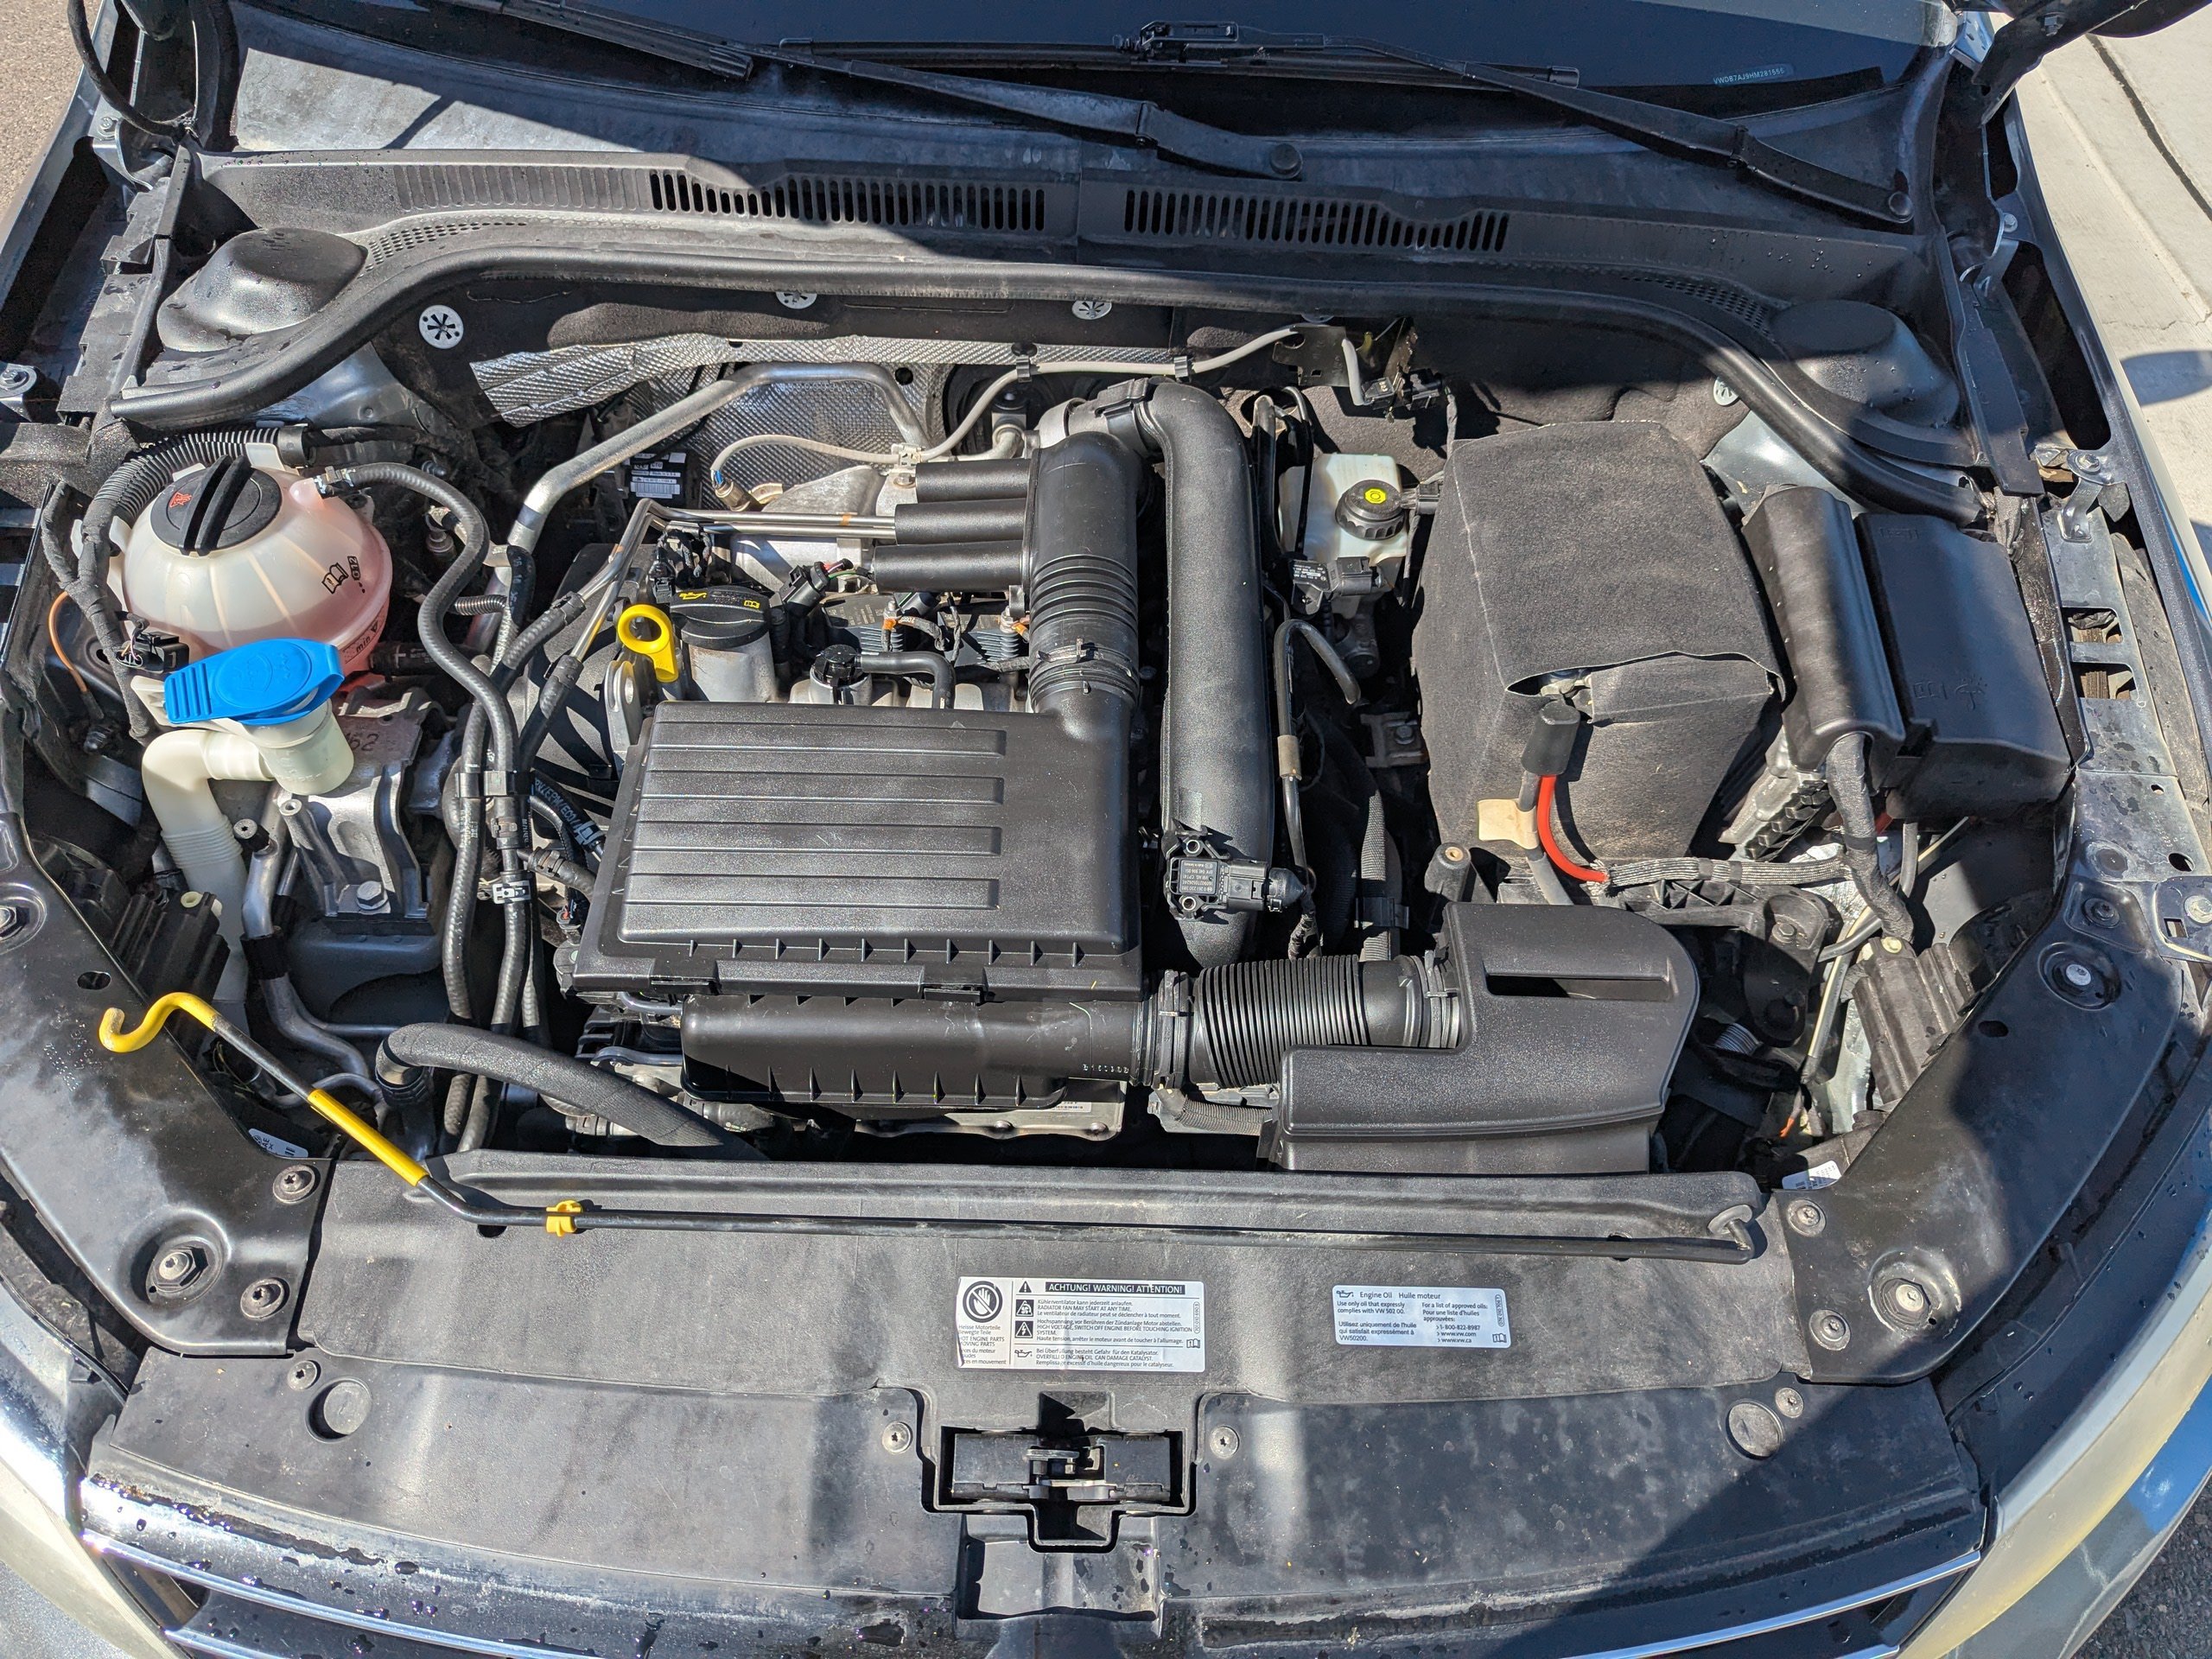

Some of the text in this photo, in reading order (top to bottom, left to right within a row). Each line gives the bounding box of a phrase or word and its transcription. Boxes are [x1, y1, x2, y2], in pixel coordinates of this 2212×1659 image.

[356, 636, 371, 653] min
[1093, 1285, 1134, 1293] WARNING!
[1136, 1285, 1182, 1293] ATTENTION!
